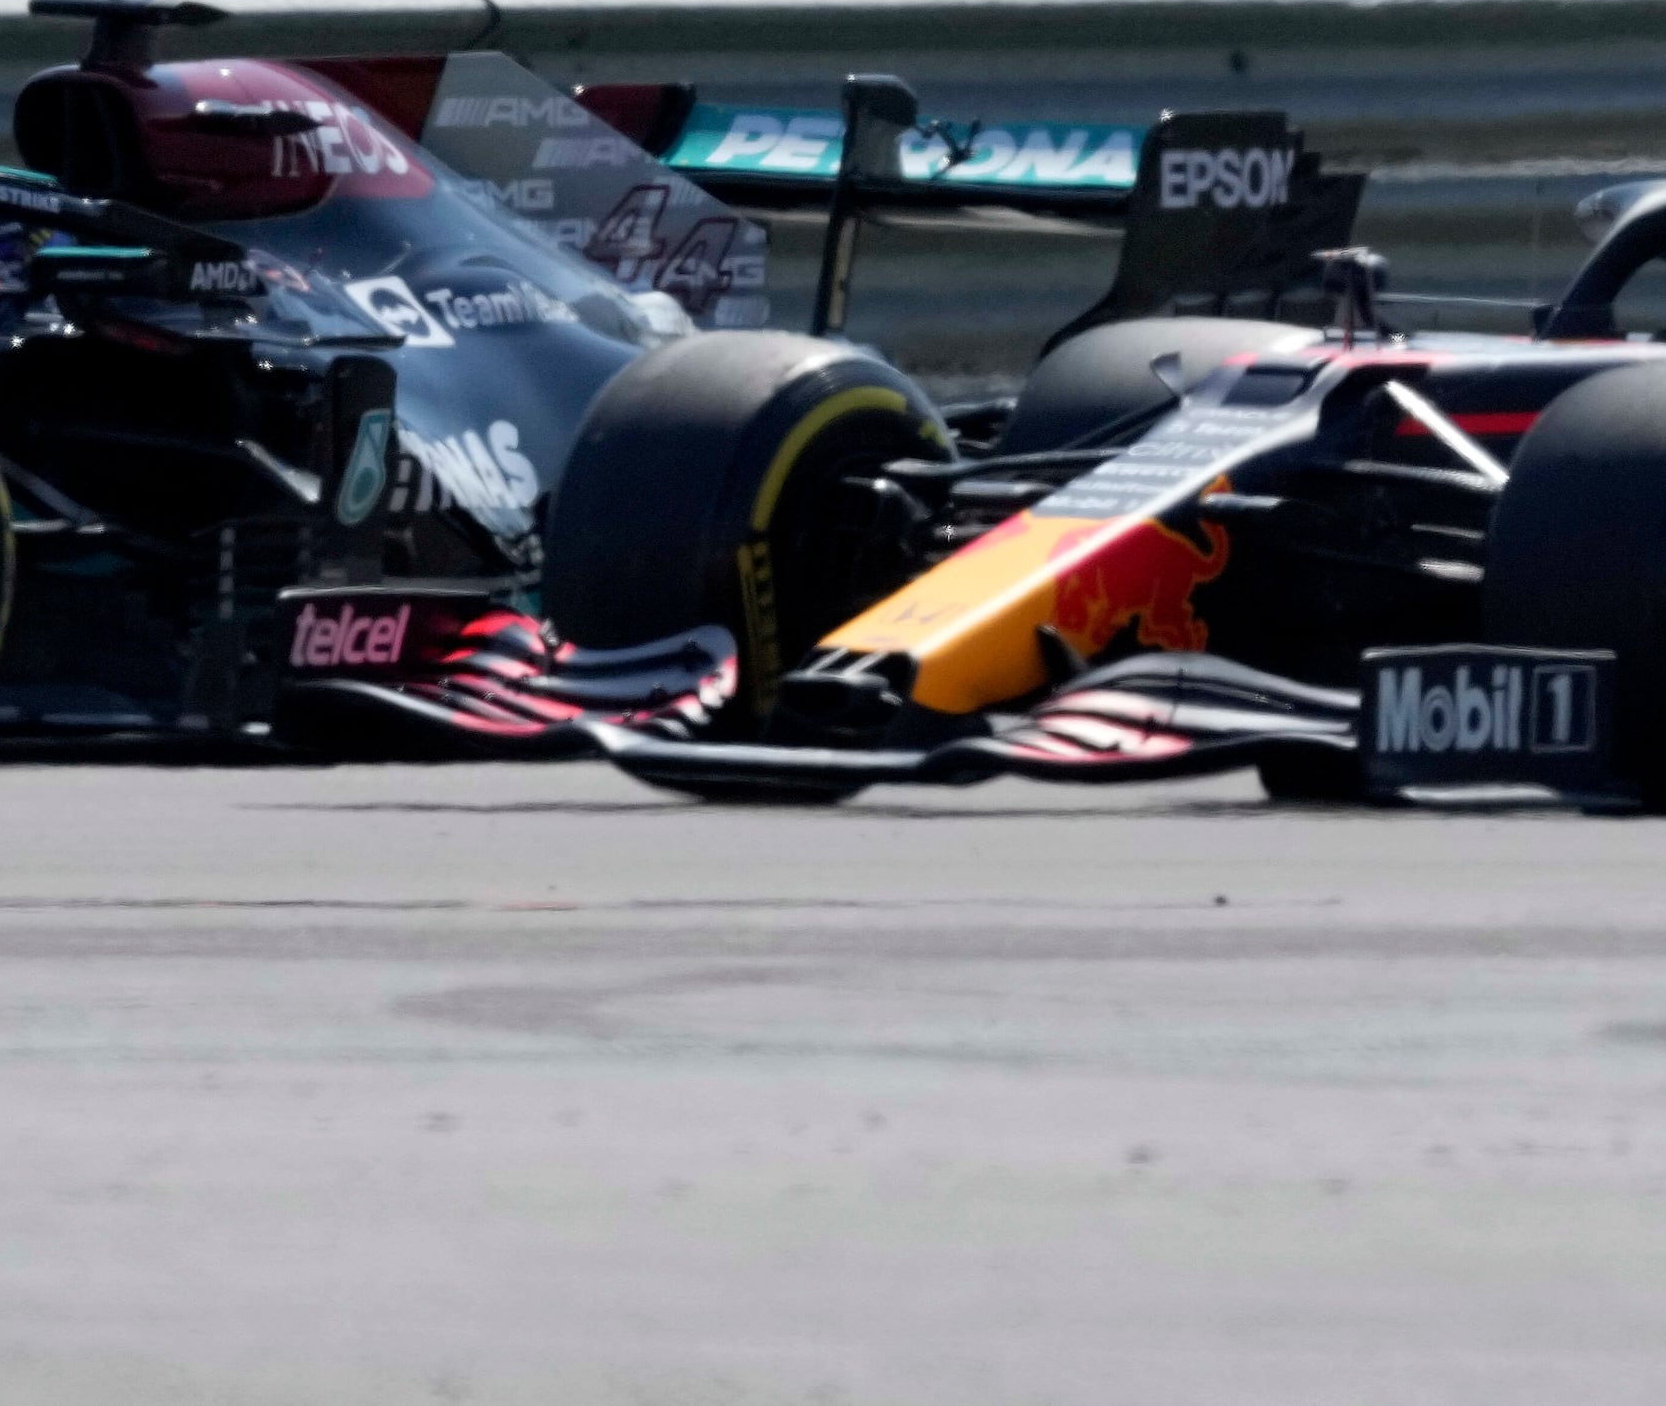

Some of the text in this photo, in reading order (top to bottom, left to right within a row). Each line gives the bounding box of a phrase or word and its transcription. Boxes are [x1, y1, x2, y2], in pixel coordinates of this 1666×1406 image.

[706, 113, 1136, 189] PERONA
[1160, 150, 1294, 208] EPSON
[290, 602, 412, 667] telcel
[1377, 666, 1523, 752] Mobil
